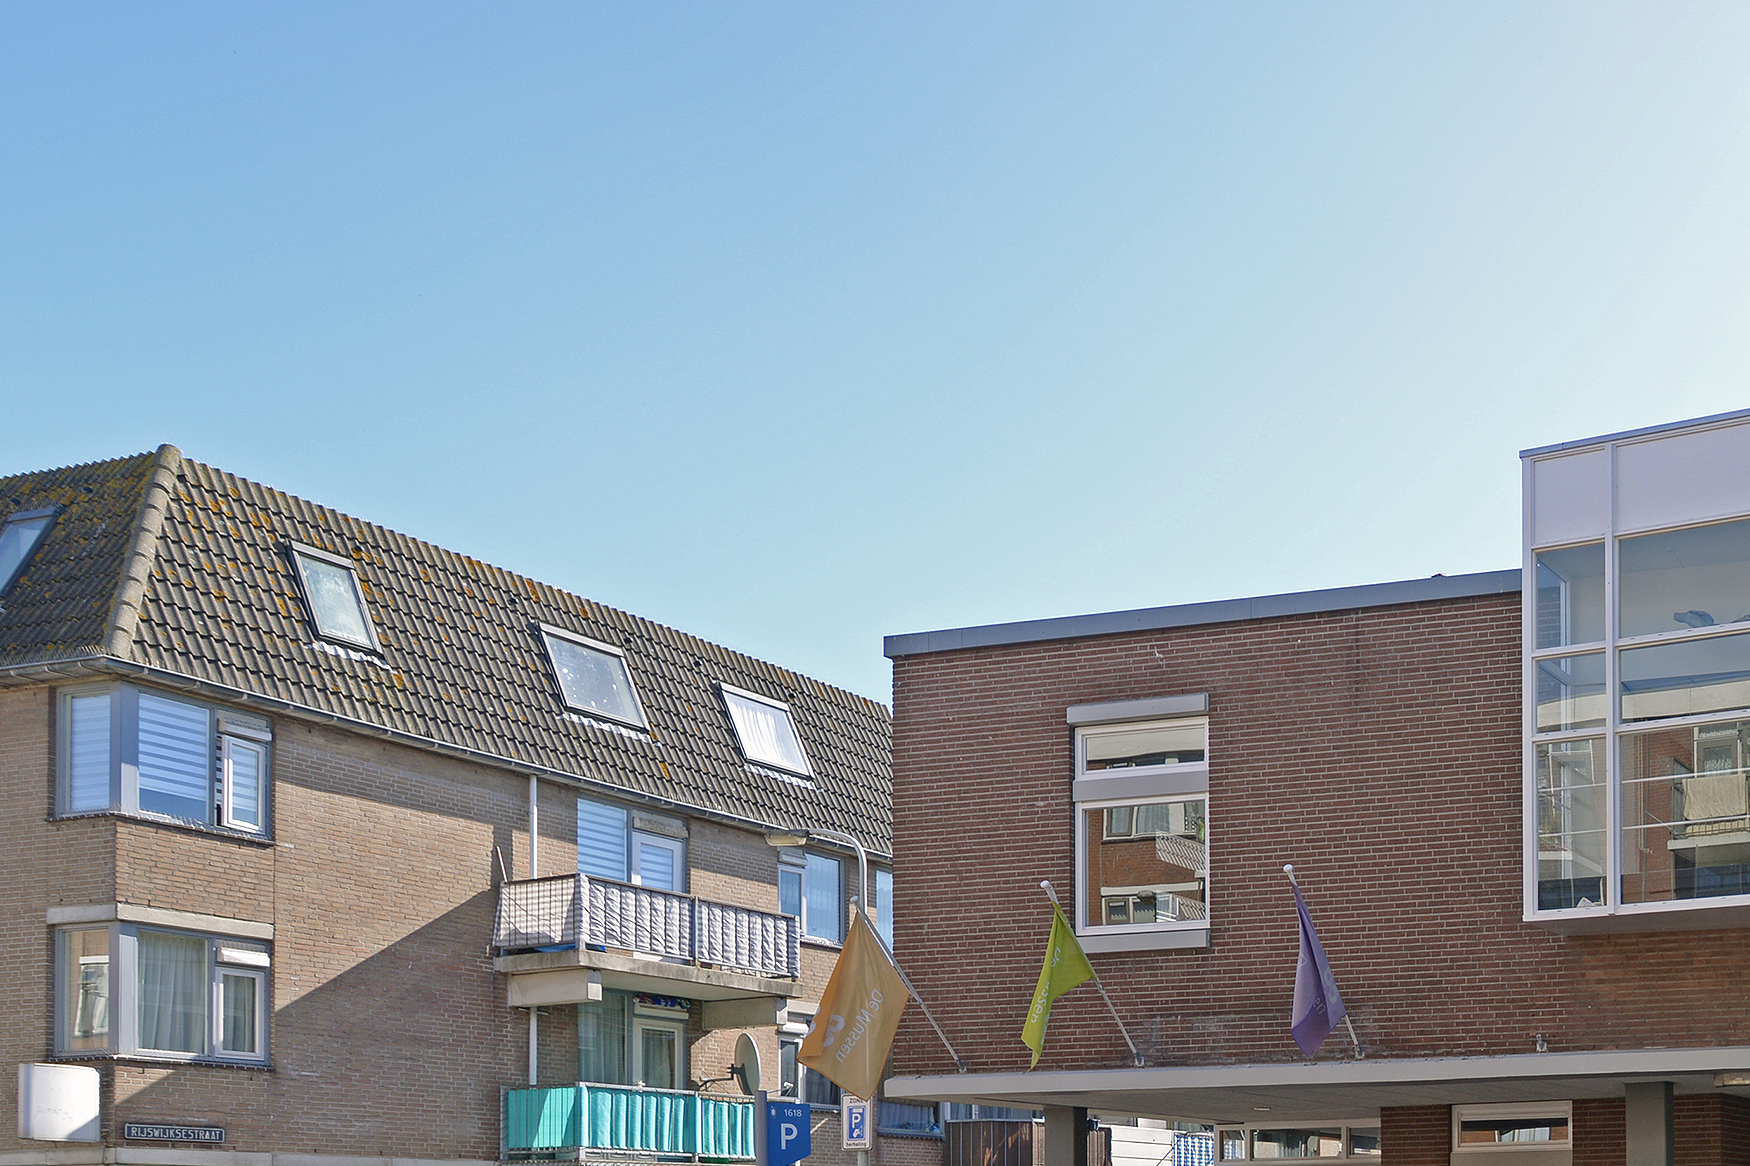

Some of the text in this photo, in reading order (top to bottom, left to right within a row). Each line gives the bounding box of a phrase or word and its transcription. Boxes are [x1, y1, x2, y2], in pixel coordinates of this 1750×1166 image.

[784, 1108, 802, 1117] 1618
[131, 1126, 220, 1140] RIJSWIJKSESTRAAT
[780, 1123, 798, 1150] P
